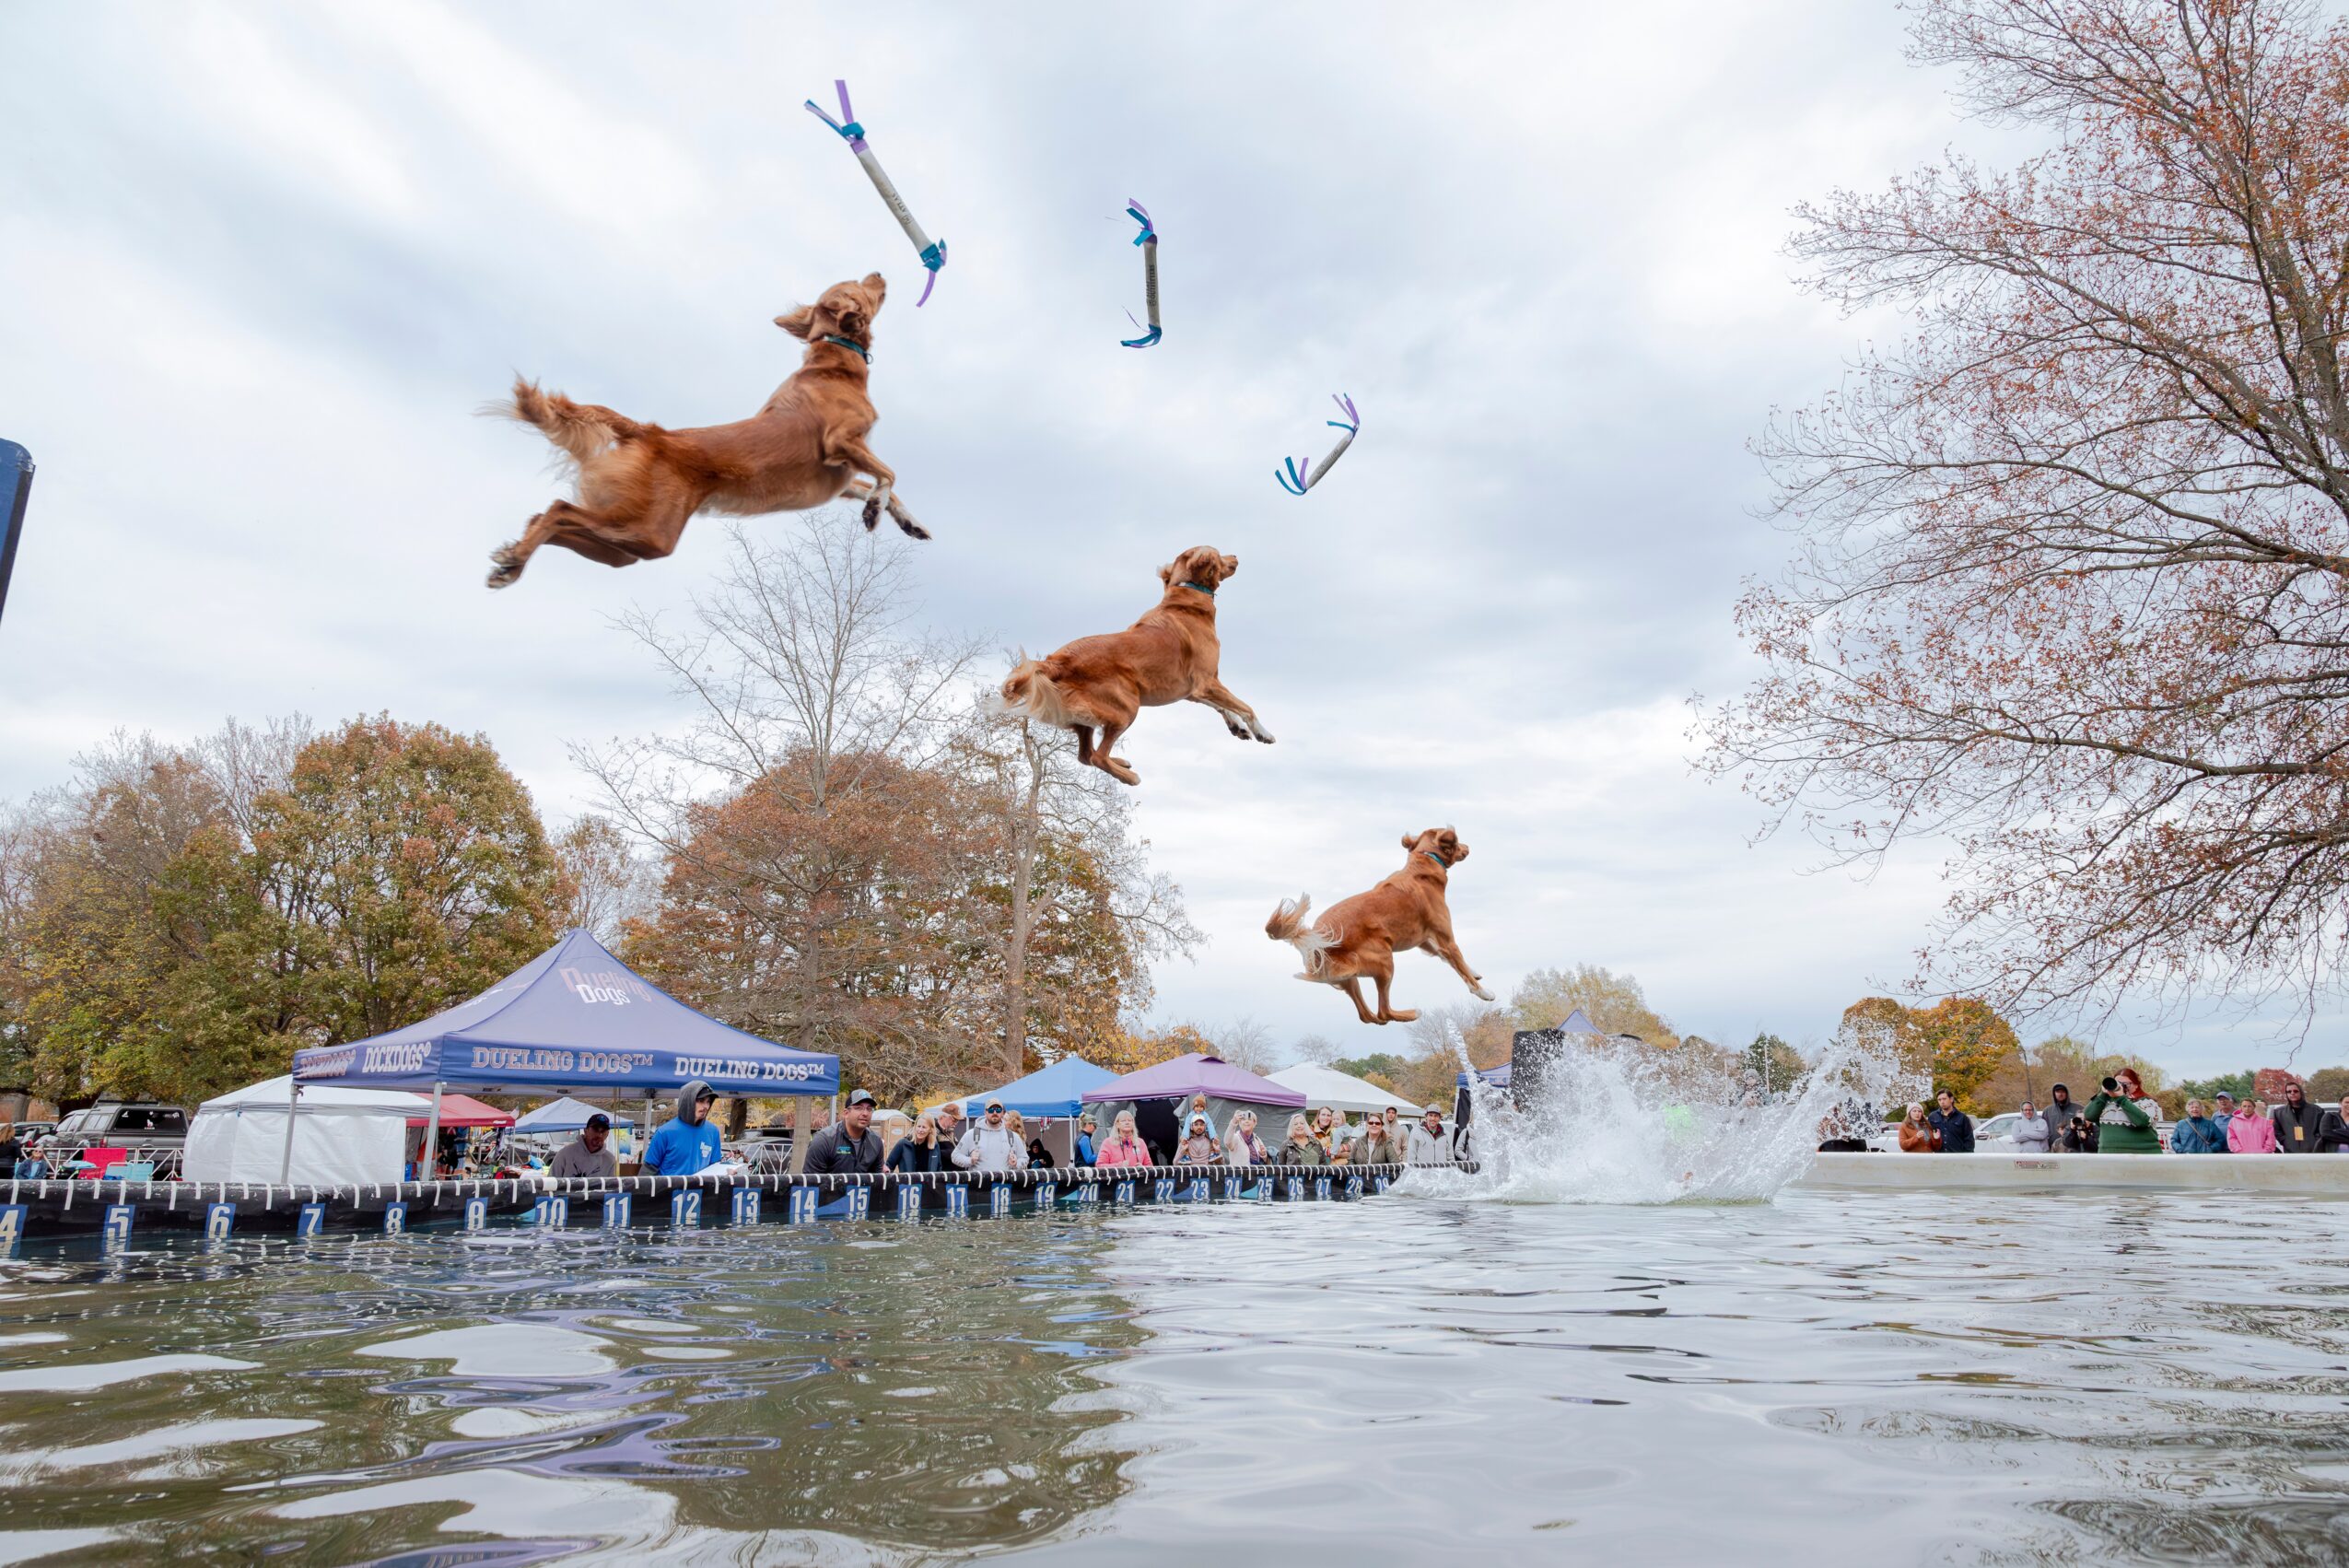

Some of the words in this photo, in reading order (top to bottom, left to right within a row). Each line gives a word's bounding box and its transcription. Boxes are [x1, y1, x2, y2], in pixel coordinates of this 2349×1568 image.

[576, 984, 631, 1006] Dogs
[471, 1047, 574, 1072] DUELING
[674, 1057, 760, 1080] DUELING
[992, 1186, 1010, 1211] 18
[1036, 1184, 1055, 1206] 19
[1079, 1183, 1099, 1201] 20
[1117, 1183, 1134, 1203] 21
[1157, 1181, 1174, 1200] 22
[1191, 1180, 1209, 1199] 23
[1226, 1179, 1241, 1198] 24
[1257, 1178, 1272, 1197] 25
[1289, 1177, 1303, 1196] 26
[1316, 1178, 1332, 1196] 27
[1346, 1178, 1363, 1195] 28
[673, 1192, 700, 1224] 12
[733, 1191, 758, 1223] 13
[792, 1189, 816, 1215] 14
[847, 1188, 869, 1212] 15
[900, 1187, 920, 1211] 16
[947, 1187, 966, 1211] 17
[208, 1205, 230, 1238] 6
[304, 1208, 321, 1235] 7
[386, 1208, 403, 1233] 8
[536, 1199, 566, 1226] 10
[605, 1197, 629, 1227] 11
[0, 1210, 18, 1251] 4
[107, 1208, 130, 1243] 5
